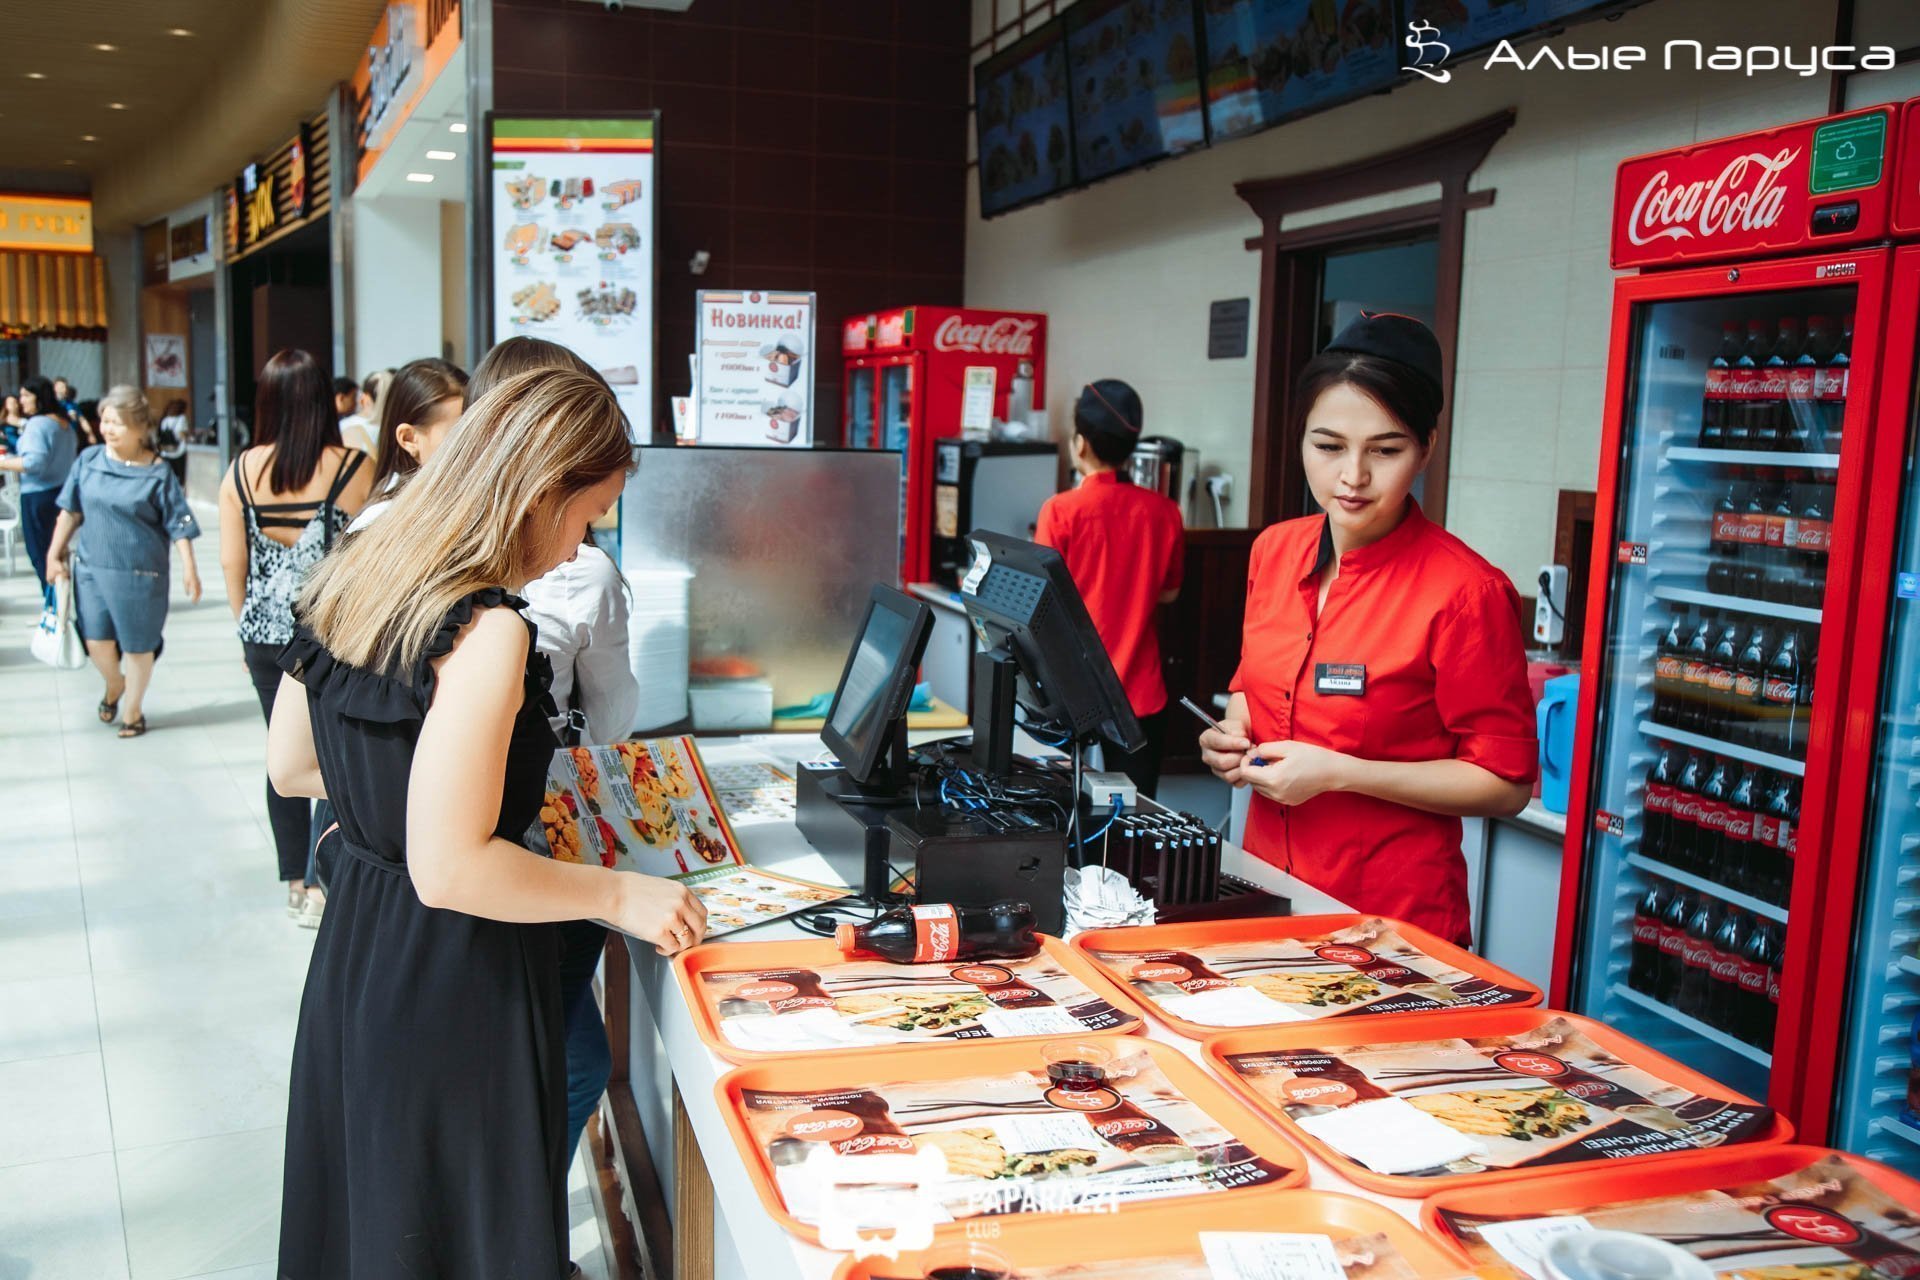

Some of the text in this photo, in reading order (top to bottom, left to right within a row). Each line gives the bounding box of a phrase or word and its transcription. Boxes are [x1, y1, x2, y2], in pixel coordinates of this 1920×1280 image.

[1628, 145, 1802, 247] Coca-Cola
[711, 308, 803, 329] Новинка!
[934, 315, 1038, 355] Coca-Cola
[1366, 998, 1437, 1012] ВКУСНЕЕ!
[1290, 1083, 1348, 1100] Coca-Cola
[792, 1117, 858, 1135] Coca-Cola
[1095, 1118, 1158, 1138] Coca-Cola
[1580, 1109, 1739, 1150] ВМЕСТЕ ВКУСНЕЕ!
[839, 1136, 914, 1154] Coca-Cola
